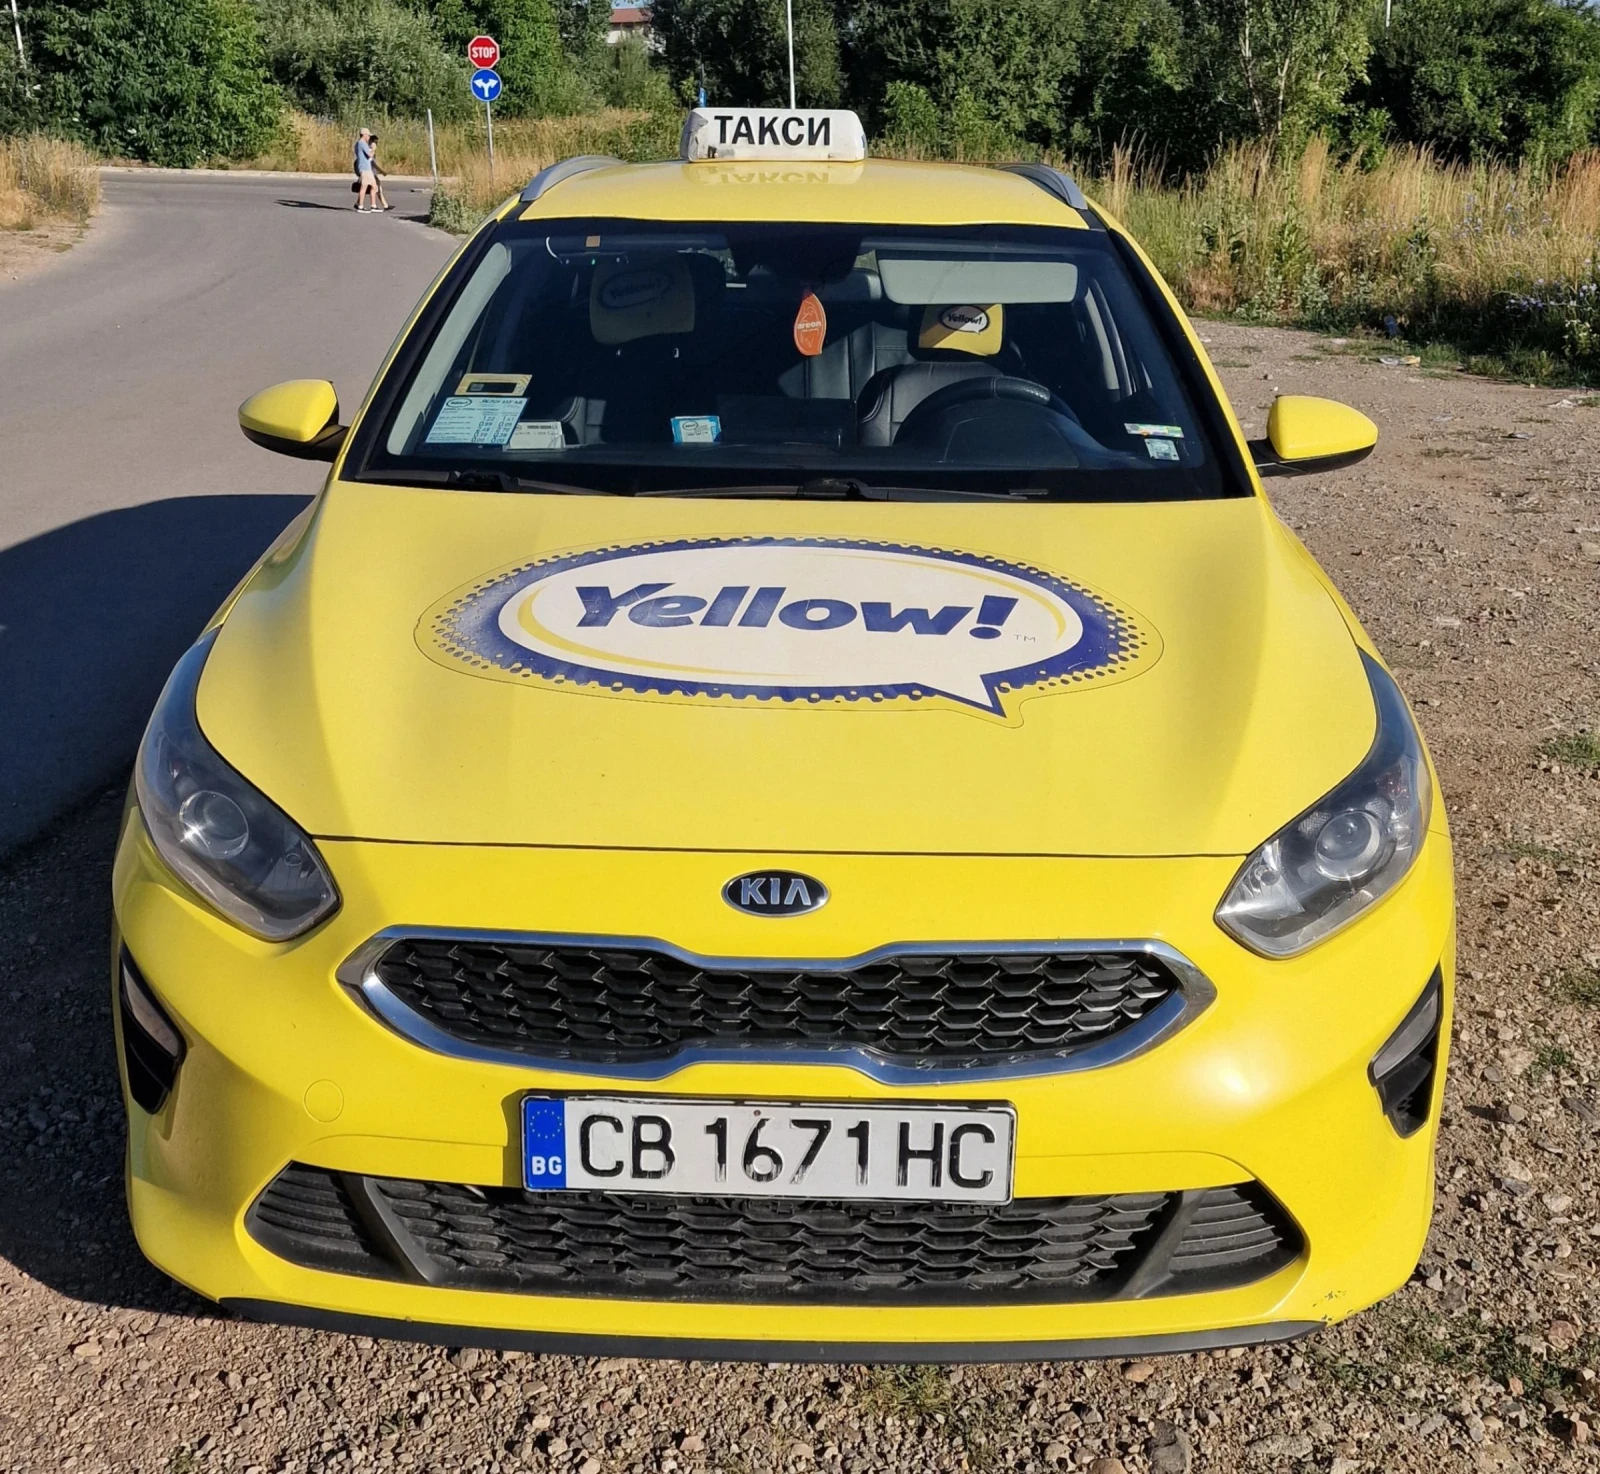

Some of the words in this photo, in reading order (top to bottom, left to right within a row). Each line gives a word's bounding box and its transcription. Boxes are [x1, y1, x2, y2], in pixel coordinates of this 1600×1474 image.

[472, 47, 495, 58] STOP
[714, 115, 830, 146] ТАКСИ
[576, 583, 1019, 639] Yellow!
[740, 878, 812, 905] KIA
[532, 1156, 562, 1175] BG
[704, 1117, 873, 1186] 1671
